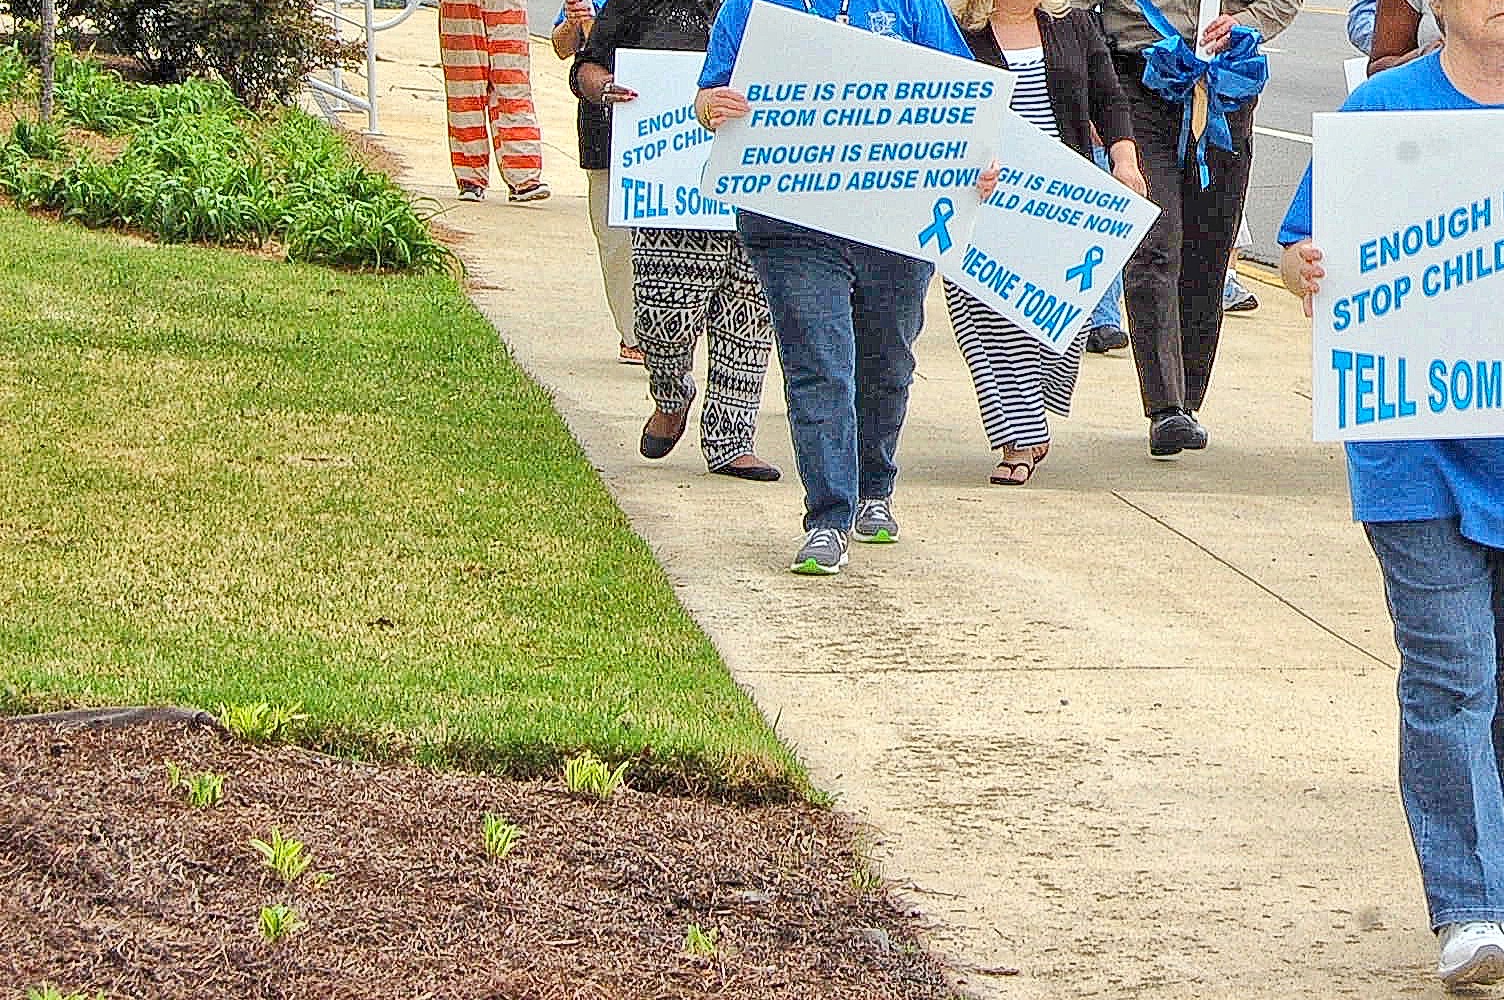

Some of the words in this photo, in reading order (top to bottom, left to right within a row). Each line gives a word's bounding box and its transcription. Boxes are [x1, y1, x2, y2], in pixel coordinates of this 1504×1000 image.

[747, 84, 807, 102] BLUE
[813, 83, 835, 100] IS
[842, 82, 889, 100] FOR
[894, 81, 994, 99] BRUISES
[638, 103, 695, 137] ENOU
[751, 109, 816, 128] FROM
[822, 108, 892, 126] CHILD
[900, 106, 976, 125] ABUSE
[622, 139, 667, 168] STOP
[673, 127, 714, 151] CHIL
[742, 145, 836, 166] ENOUGH
[841, 143, 862, 162] IS
[867, 141, 968, 161] ENOUGH!
[621, 177, 668, 220] TELL
[715, 174, 771, 194] STOP
[777, 172, 841, 193] CHILD
[845, 170, 917, 190] ABUSE
[924, 168, 980, 188] NOW!
[1024, 174, 1044, 192] IS
[1046, 180, 1131, 213] ENOUGH!
[982, 191, 1020, 210] ILD
[1021, 199, 1083, 227] ABUSE
[1083, 214, 1134, 239] NOW!
[1359, 198, 1491, 274] ENOUGH
[1015, 282, 1081, 342] TODAY
[1333, 275, 1411, 332] STOP
[1332, 349, 1417, 429] TELL
